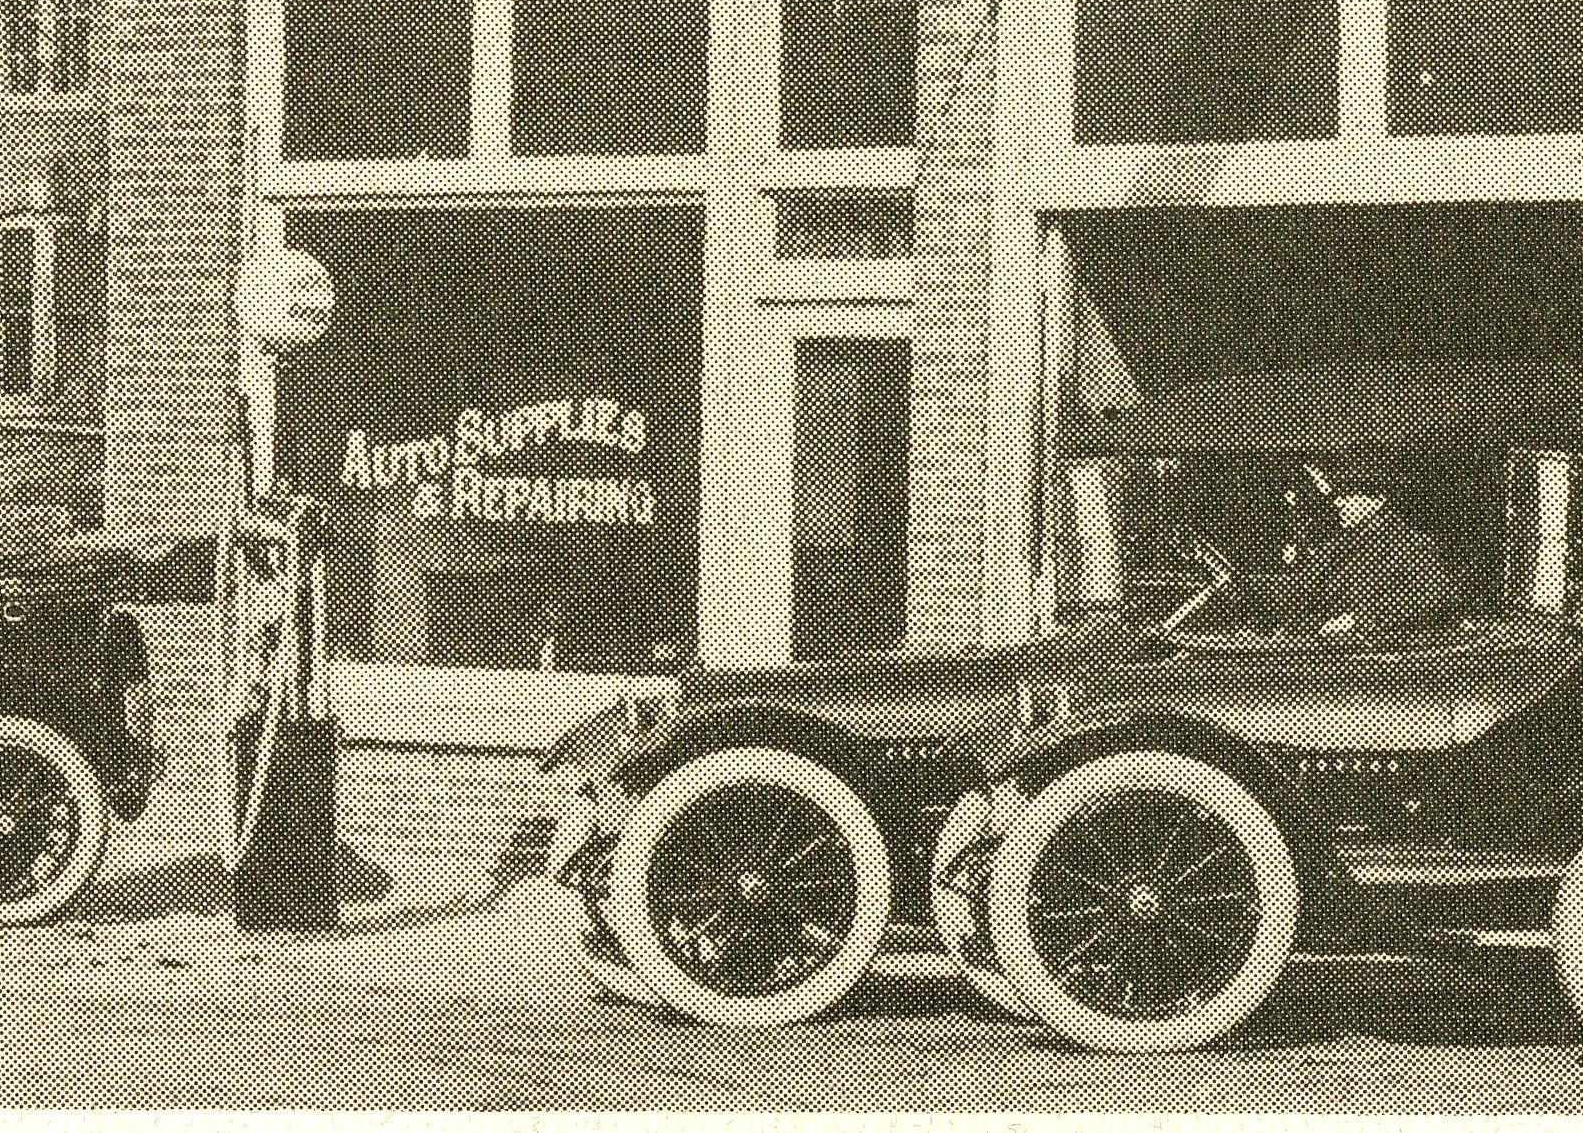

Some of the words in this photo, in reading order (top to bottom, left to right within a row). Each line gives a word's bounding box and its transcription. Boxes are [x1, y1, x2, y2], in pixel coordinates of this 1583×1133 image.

[342, 429, 448, 488] AUTO
[454, 398, 646, 467] SUPPLIES
[413, 482, 443, 520] &
[451, 466, 656, 525] REPAIRING
